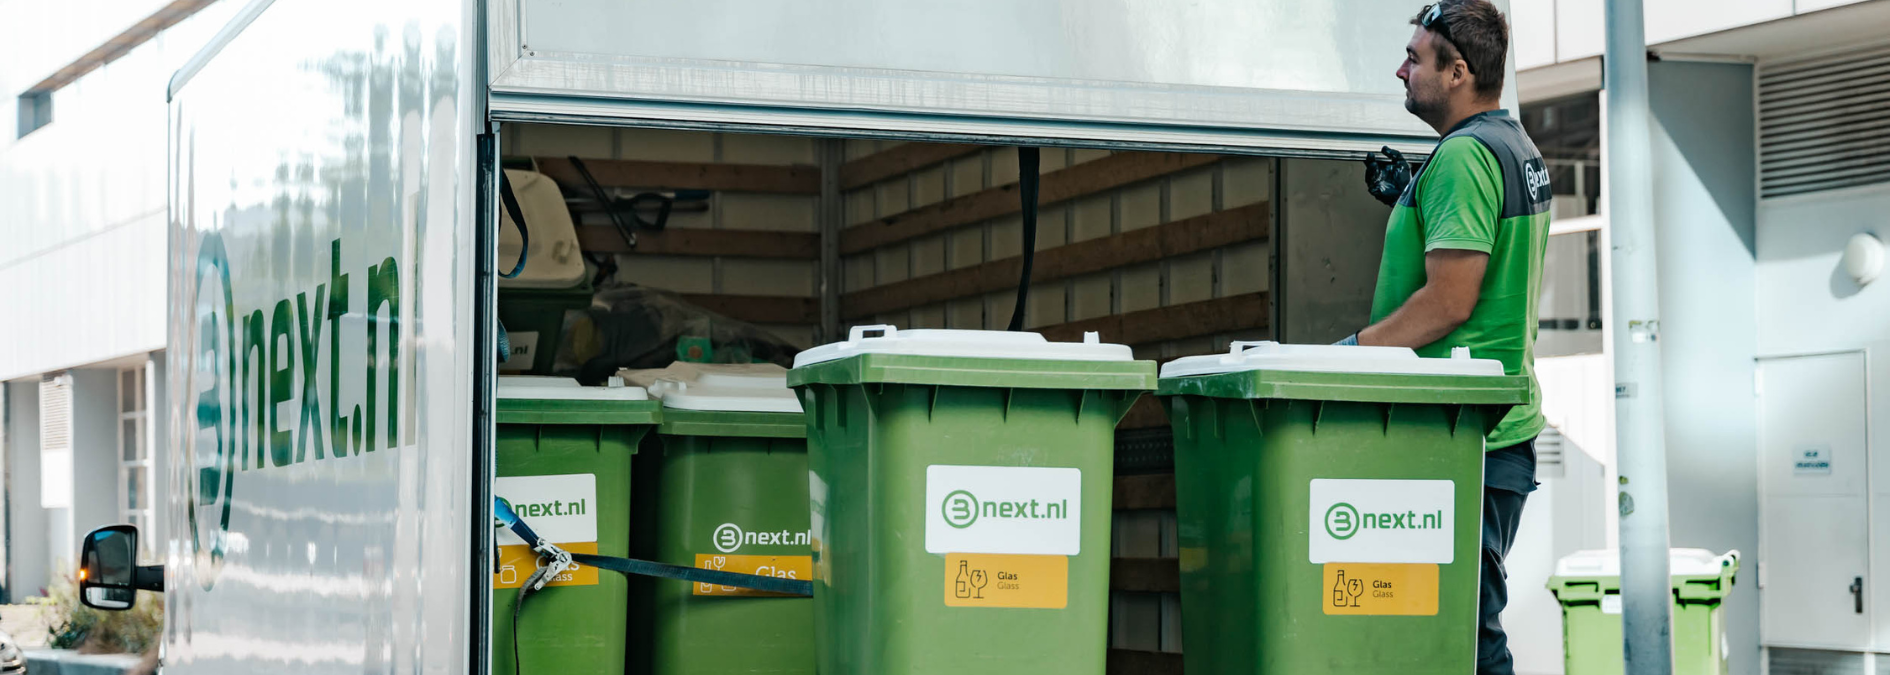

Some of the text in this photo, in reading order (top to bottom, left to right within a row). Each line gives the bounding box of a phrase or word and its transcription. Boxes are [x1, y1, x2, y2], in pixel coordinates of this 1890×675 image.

[997, 571, 1018, 580] Glas
[997, 581, 1020, 590] Glass
[1372, 580, 1392, 589] Glas
[1372, 589, 1394, 598] Glass
